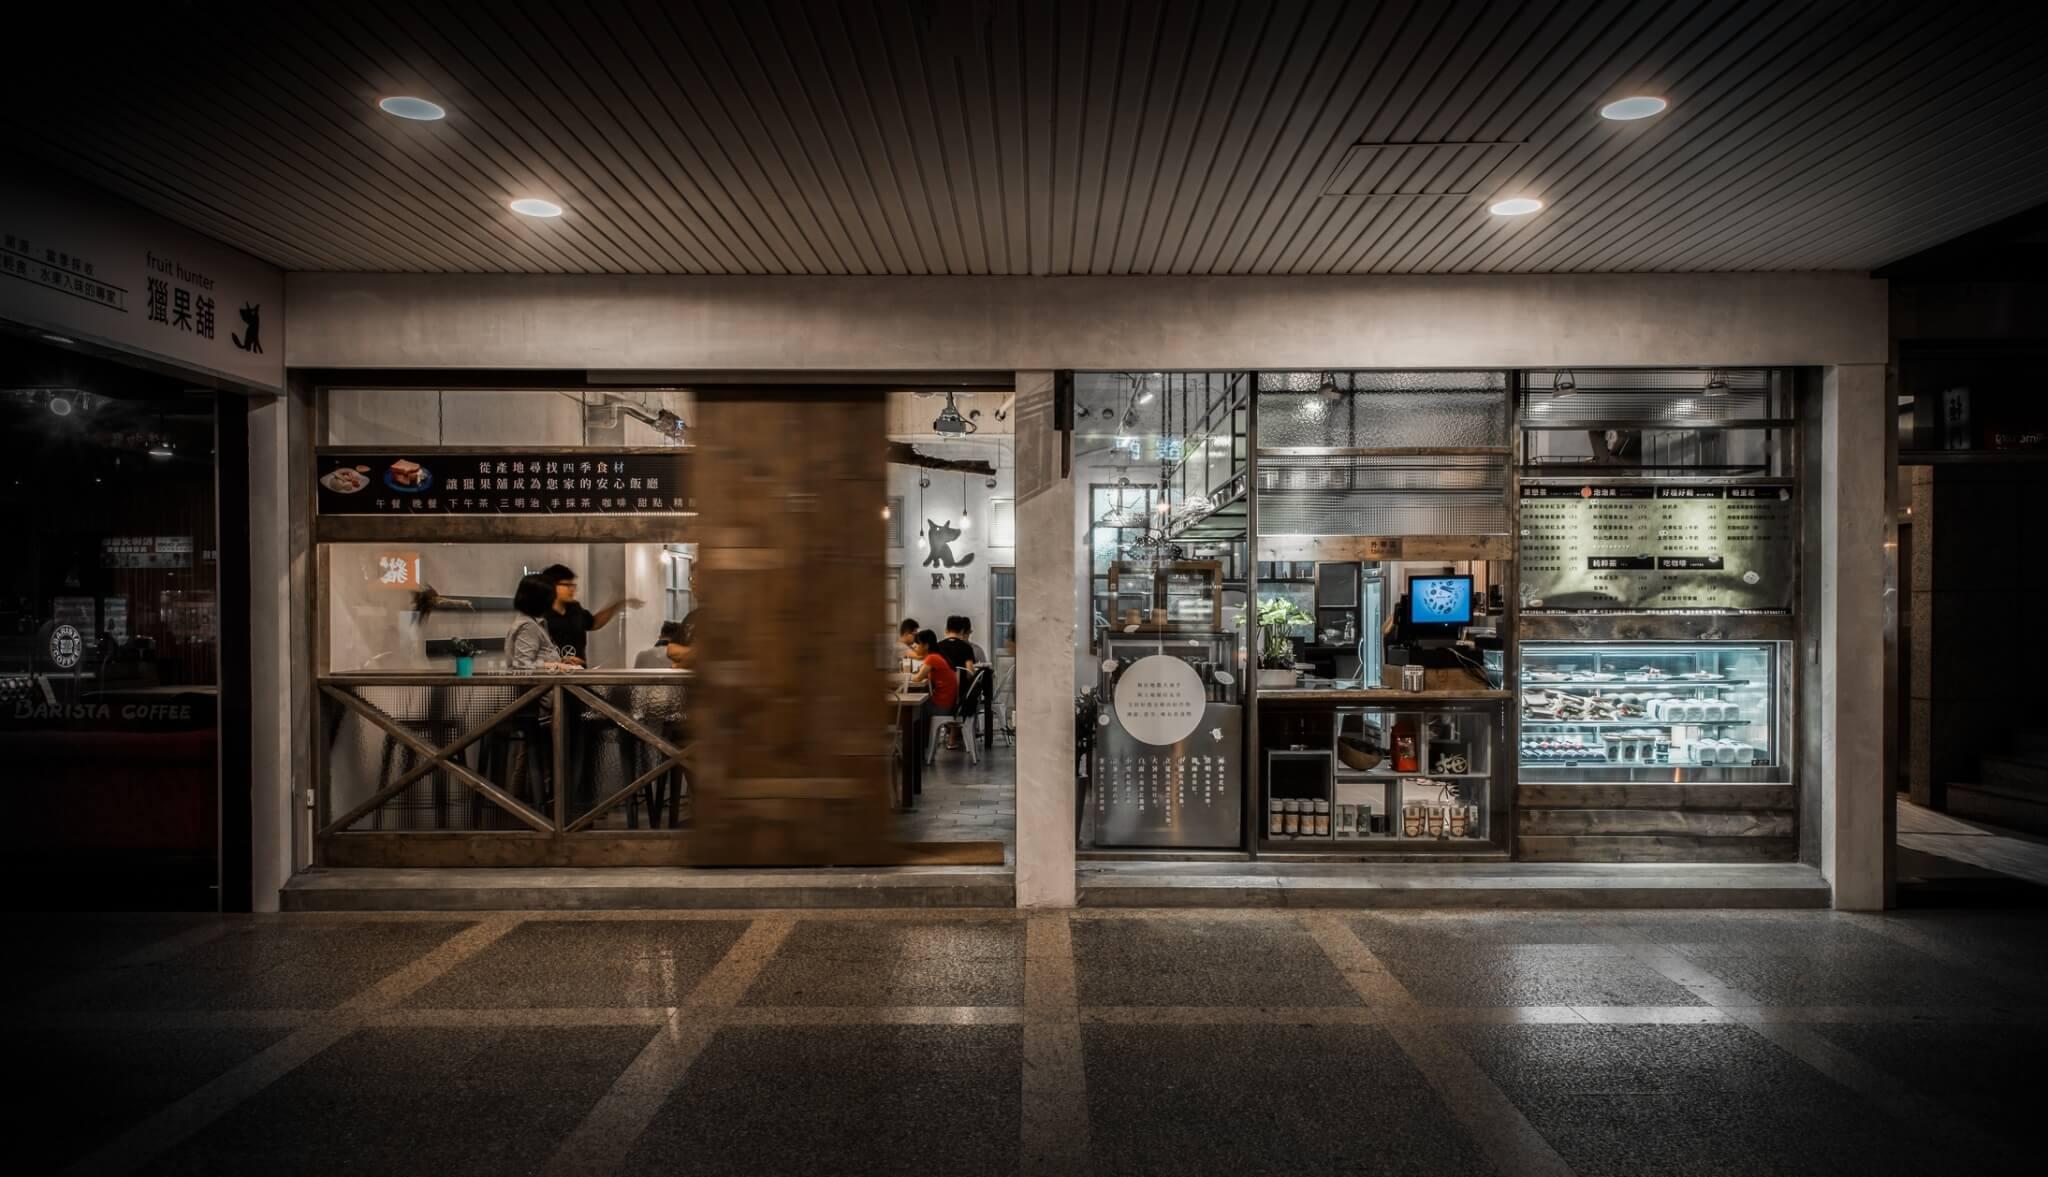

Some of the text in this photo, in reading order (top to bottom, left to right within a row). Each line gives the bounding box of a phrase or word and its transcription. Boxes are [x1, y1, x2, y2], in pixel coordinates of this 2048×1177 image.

[147, 250, 215, 291] fruit hunter
[479, 461, 625, 474] 從產地尋找四季食材
[376, 498, 401, 509] 午餐
[412, 498, 438, 509] 晚餐
[448, 498, 489, 509] 下午茶
[500, 498, 540, 509] 三明治
[550, 498, 591, 509] 手採茶
[601, 498, 627, 509] 咖啡
[637, 498, 663, 509] 甜點
[13, 698, 192, 721] BARISTA COFFEE
